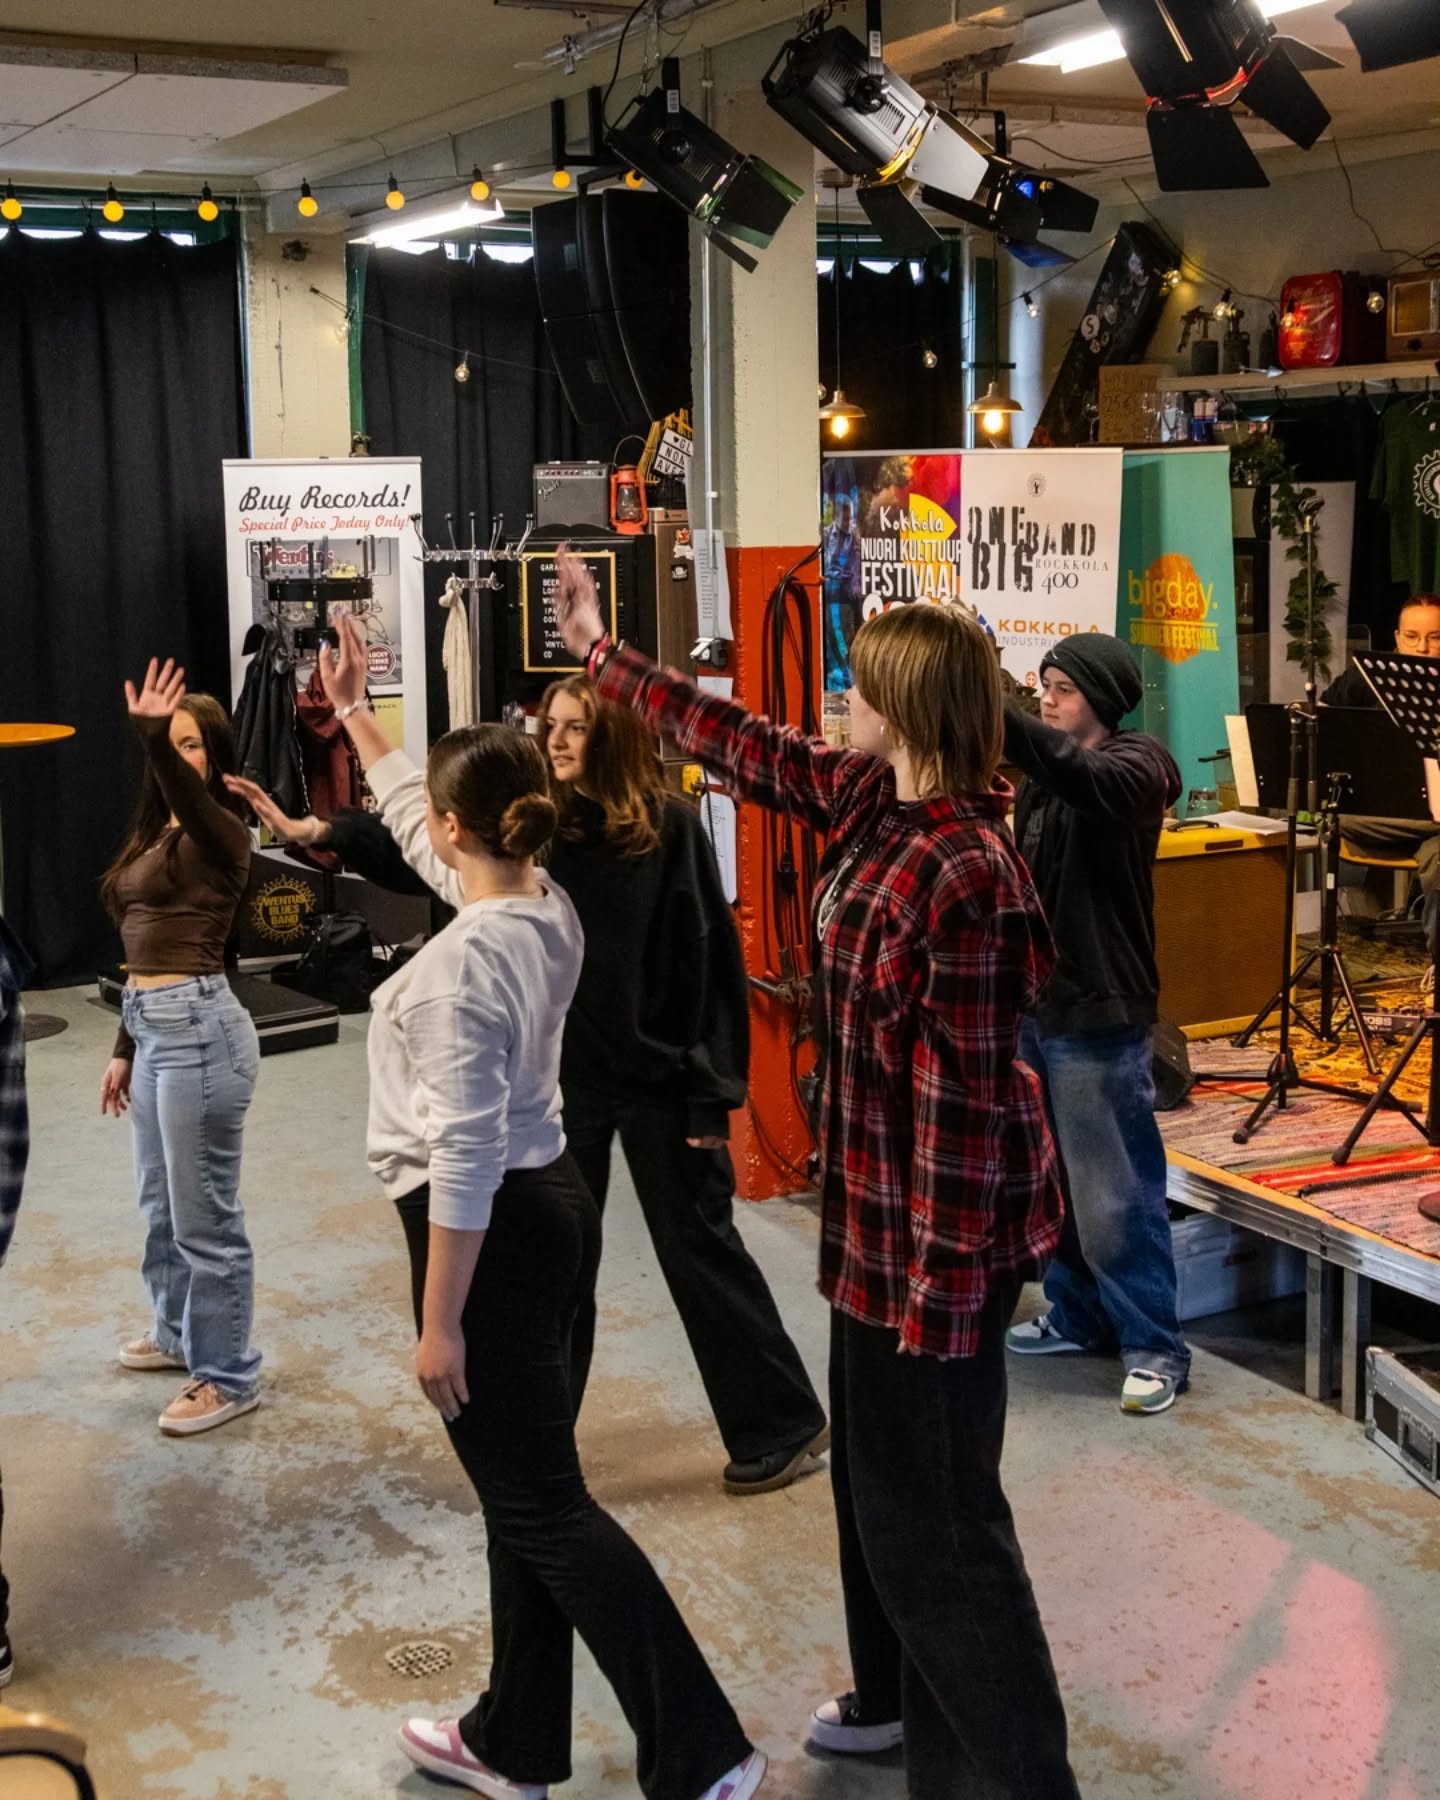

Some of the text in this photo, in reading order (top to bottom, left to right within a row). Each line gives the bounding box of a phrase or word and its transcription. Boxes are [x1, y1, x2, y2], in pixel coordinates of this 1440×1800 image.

[239, 484, 411, 517] Buy Records!
[239, 514, 411, 534] Special Price Today Only!
[880, 506, 944, 533] Kokkola
[967, 506, 1096, 556] ONE BAND
[861, 537, 897, 560] NUORI
[971, 538, 1033, 592] BIG
[1035, 558, 1110, 572] ROCKKOLA
[1041, 572, 1079, 595] 400
[998, 617, 1101, 636] KOKKOLA
[545, 641, 566, 649] VINYL
[1172, 625, 1219, 651] FESTIVAL
[543, 651, 553, 659] CD
[269, 905, 300, 915] BLUES
[271, 915, 299, 925] BAND
